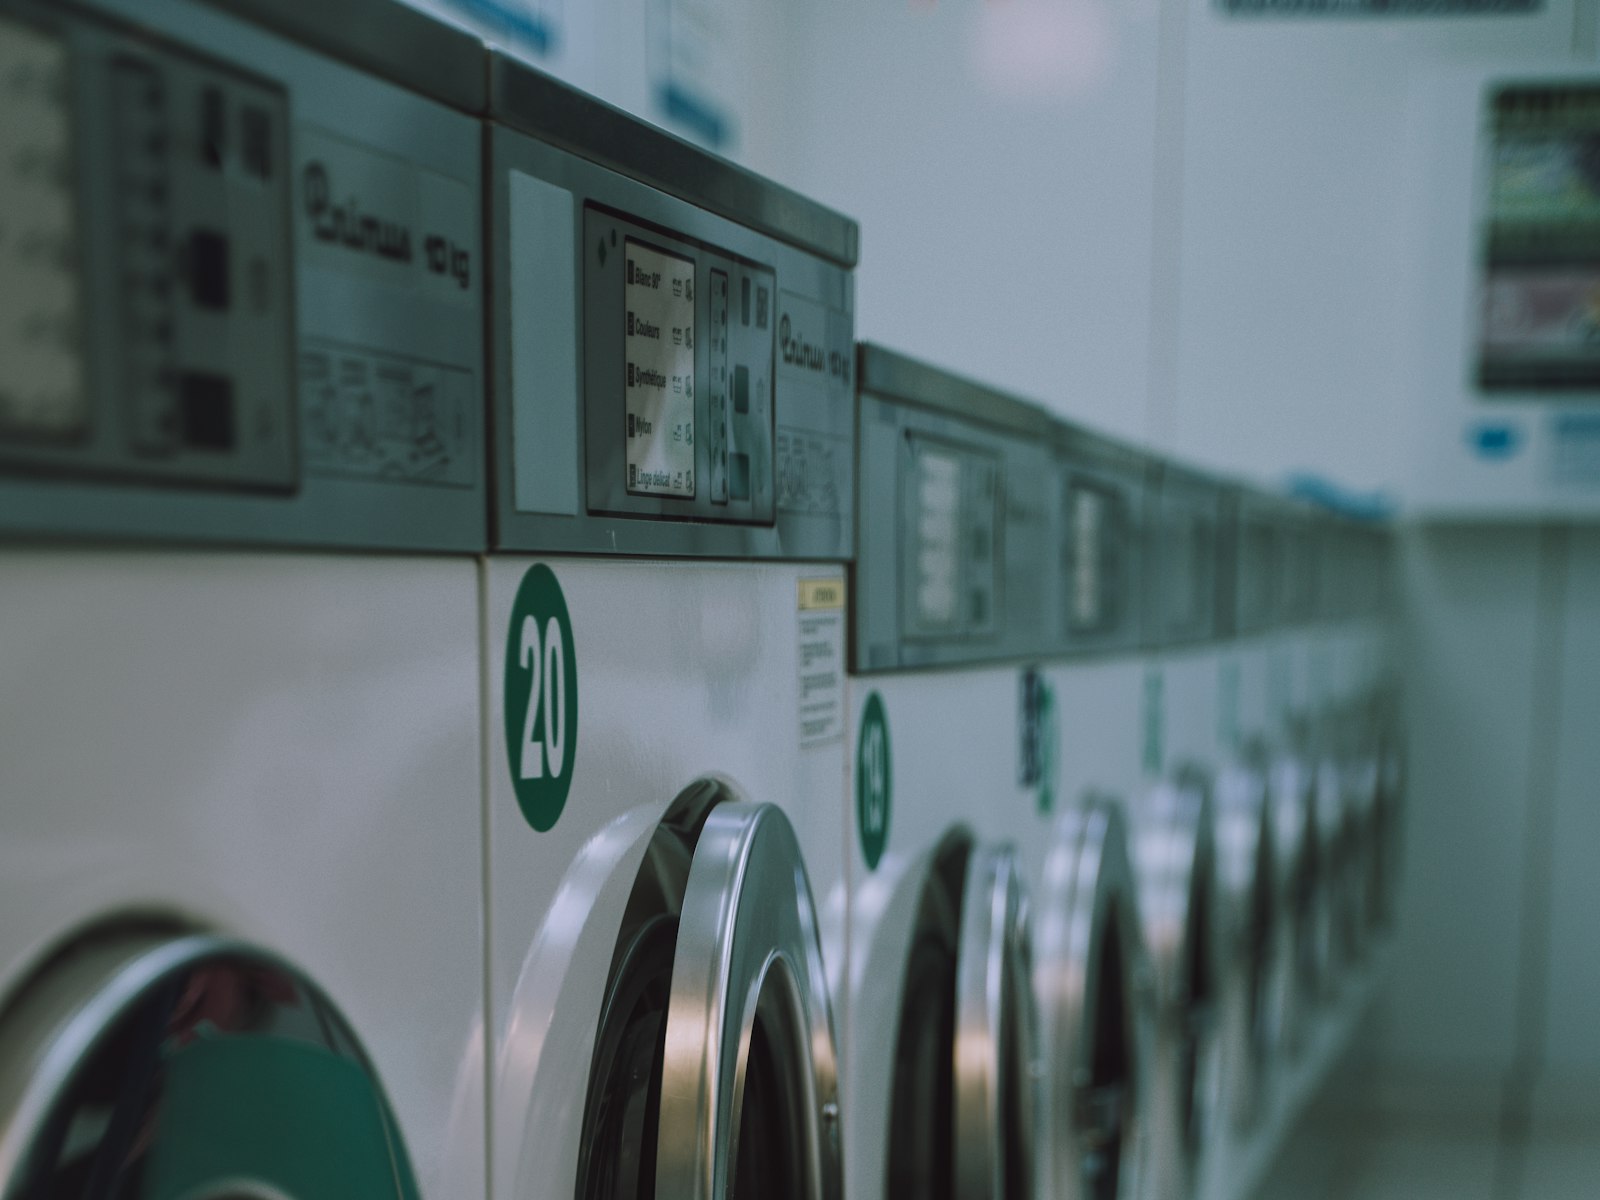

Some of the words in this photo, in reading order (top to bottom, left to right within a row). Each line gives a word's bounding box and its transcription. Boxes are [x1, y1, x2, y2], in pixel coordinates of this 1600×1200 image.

[635, 266, 651, 288] Blanc
[635, 317, 660, 340] Couleurs
[635, 415, 652, 437] Nylon
[636, 467, 652, 490] Linge
[519, 614, 566, 780] 20
